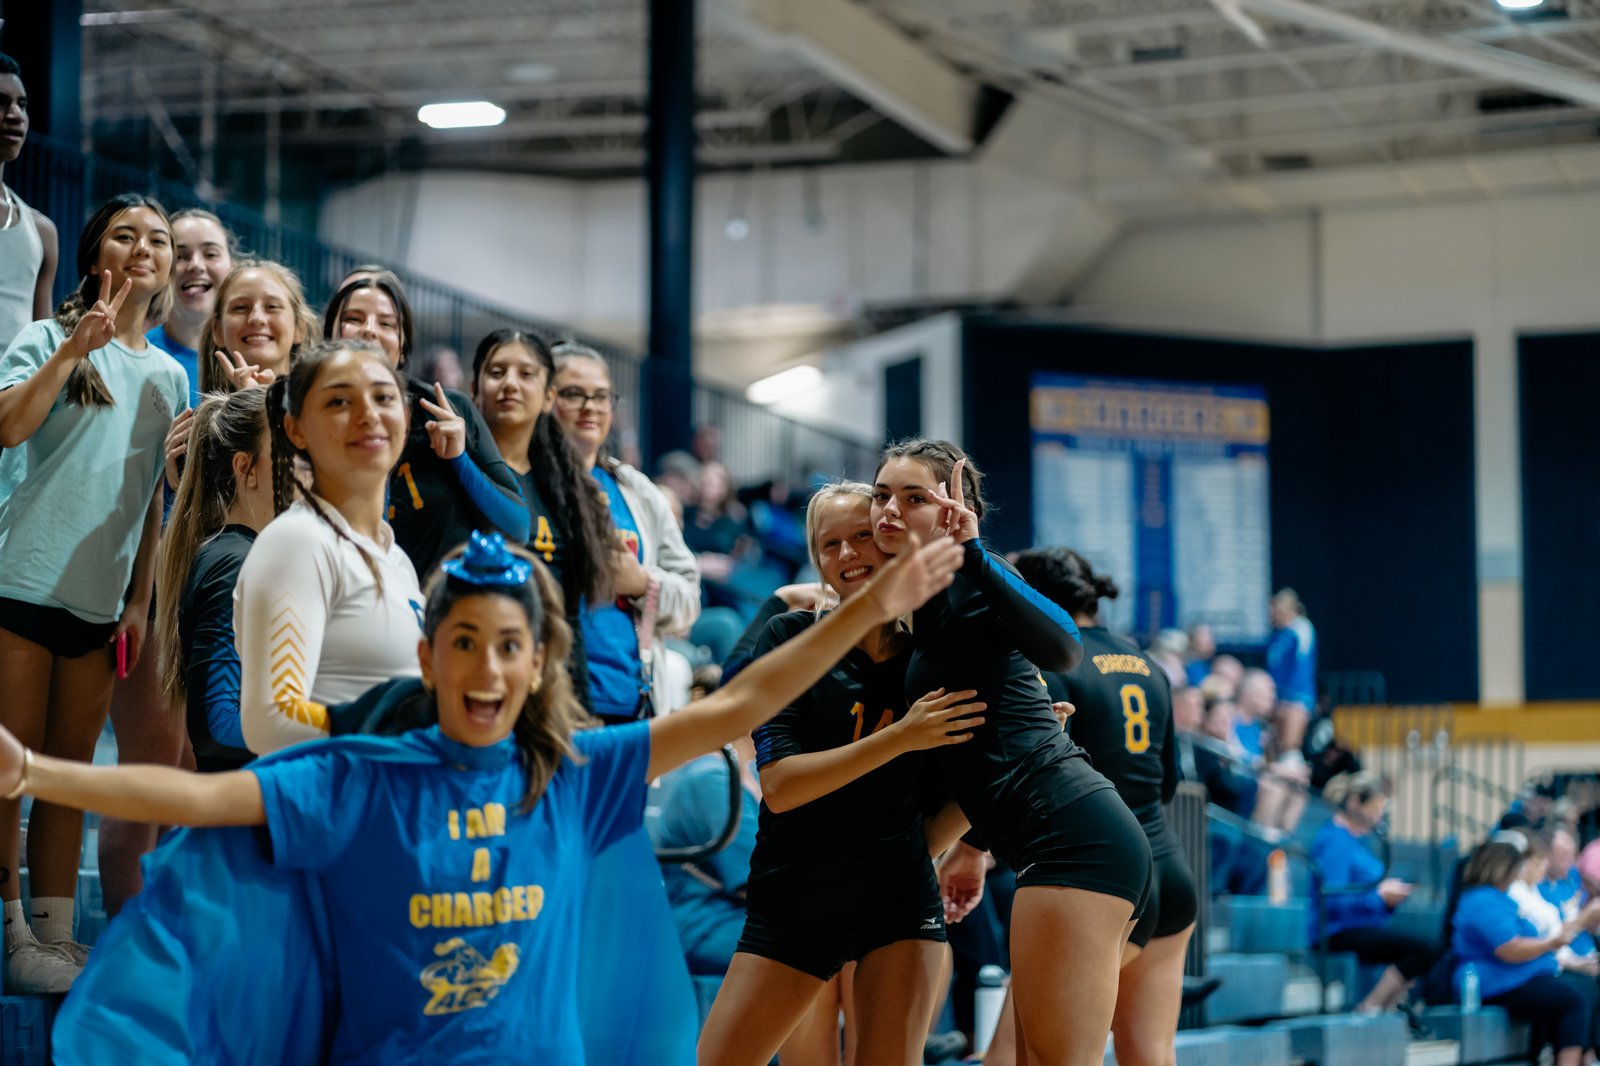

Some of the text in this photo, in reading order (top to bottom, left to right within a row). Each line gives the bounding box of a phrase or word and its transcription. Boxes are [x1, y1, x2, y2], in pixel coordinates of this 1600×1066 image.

[534, 515, 556, 562] 4
[1092, 653, 1151, 677] CHARGERS
[1120, 684, 1151, 754] 8
[448, 802, 506, 840] I AM
[471, 847, 491, 883] A
[409, 884, 545, 929] CHARGER
